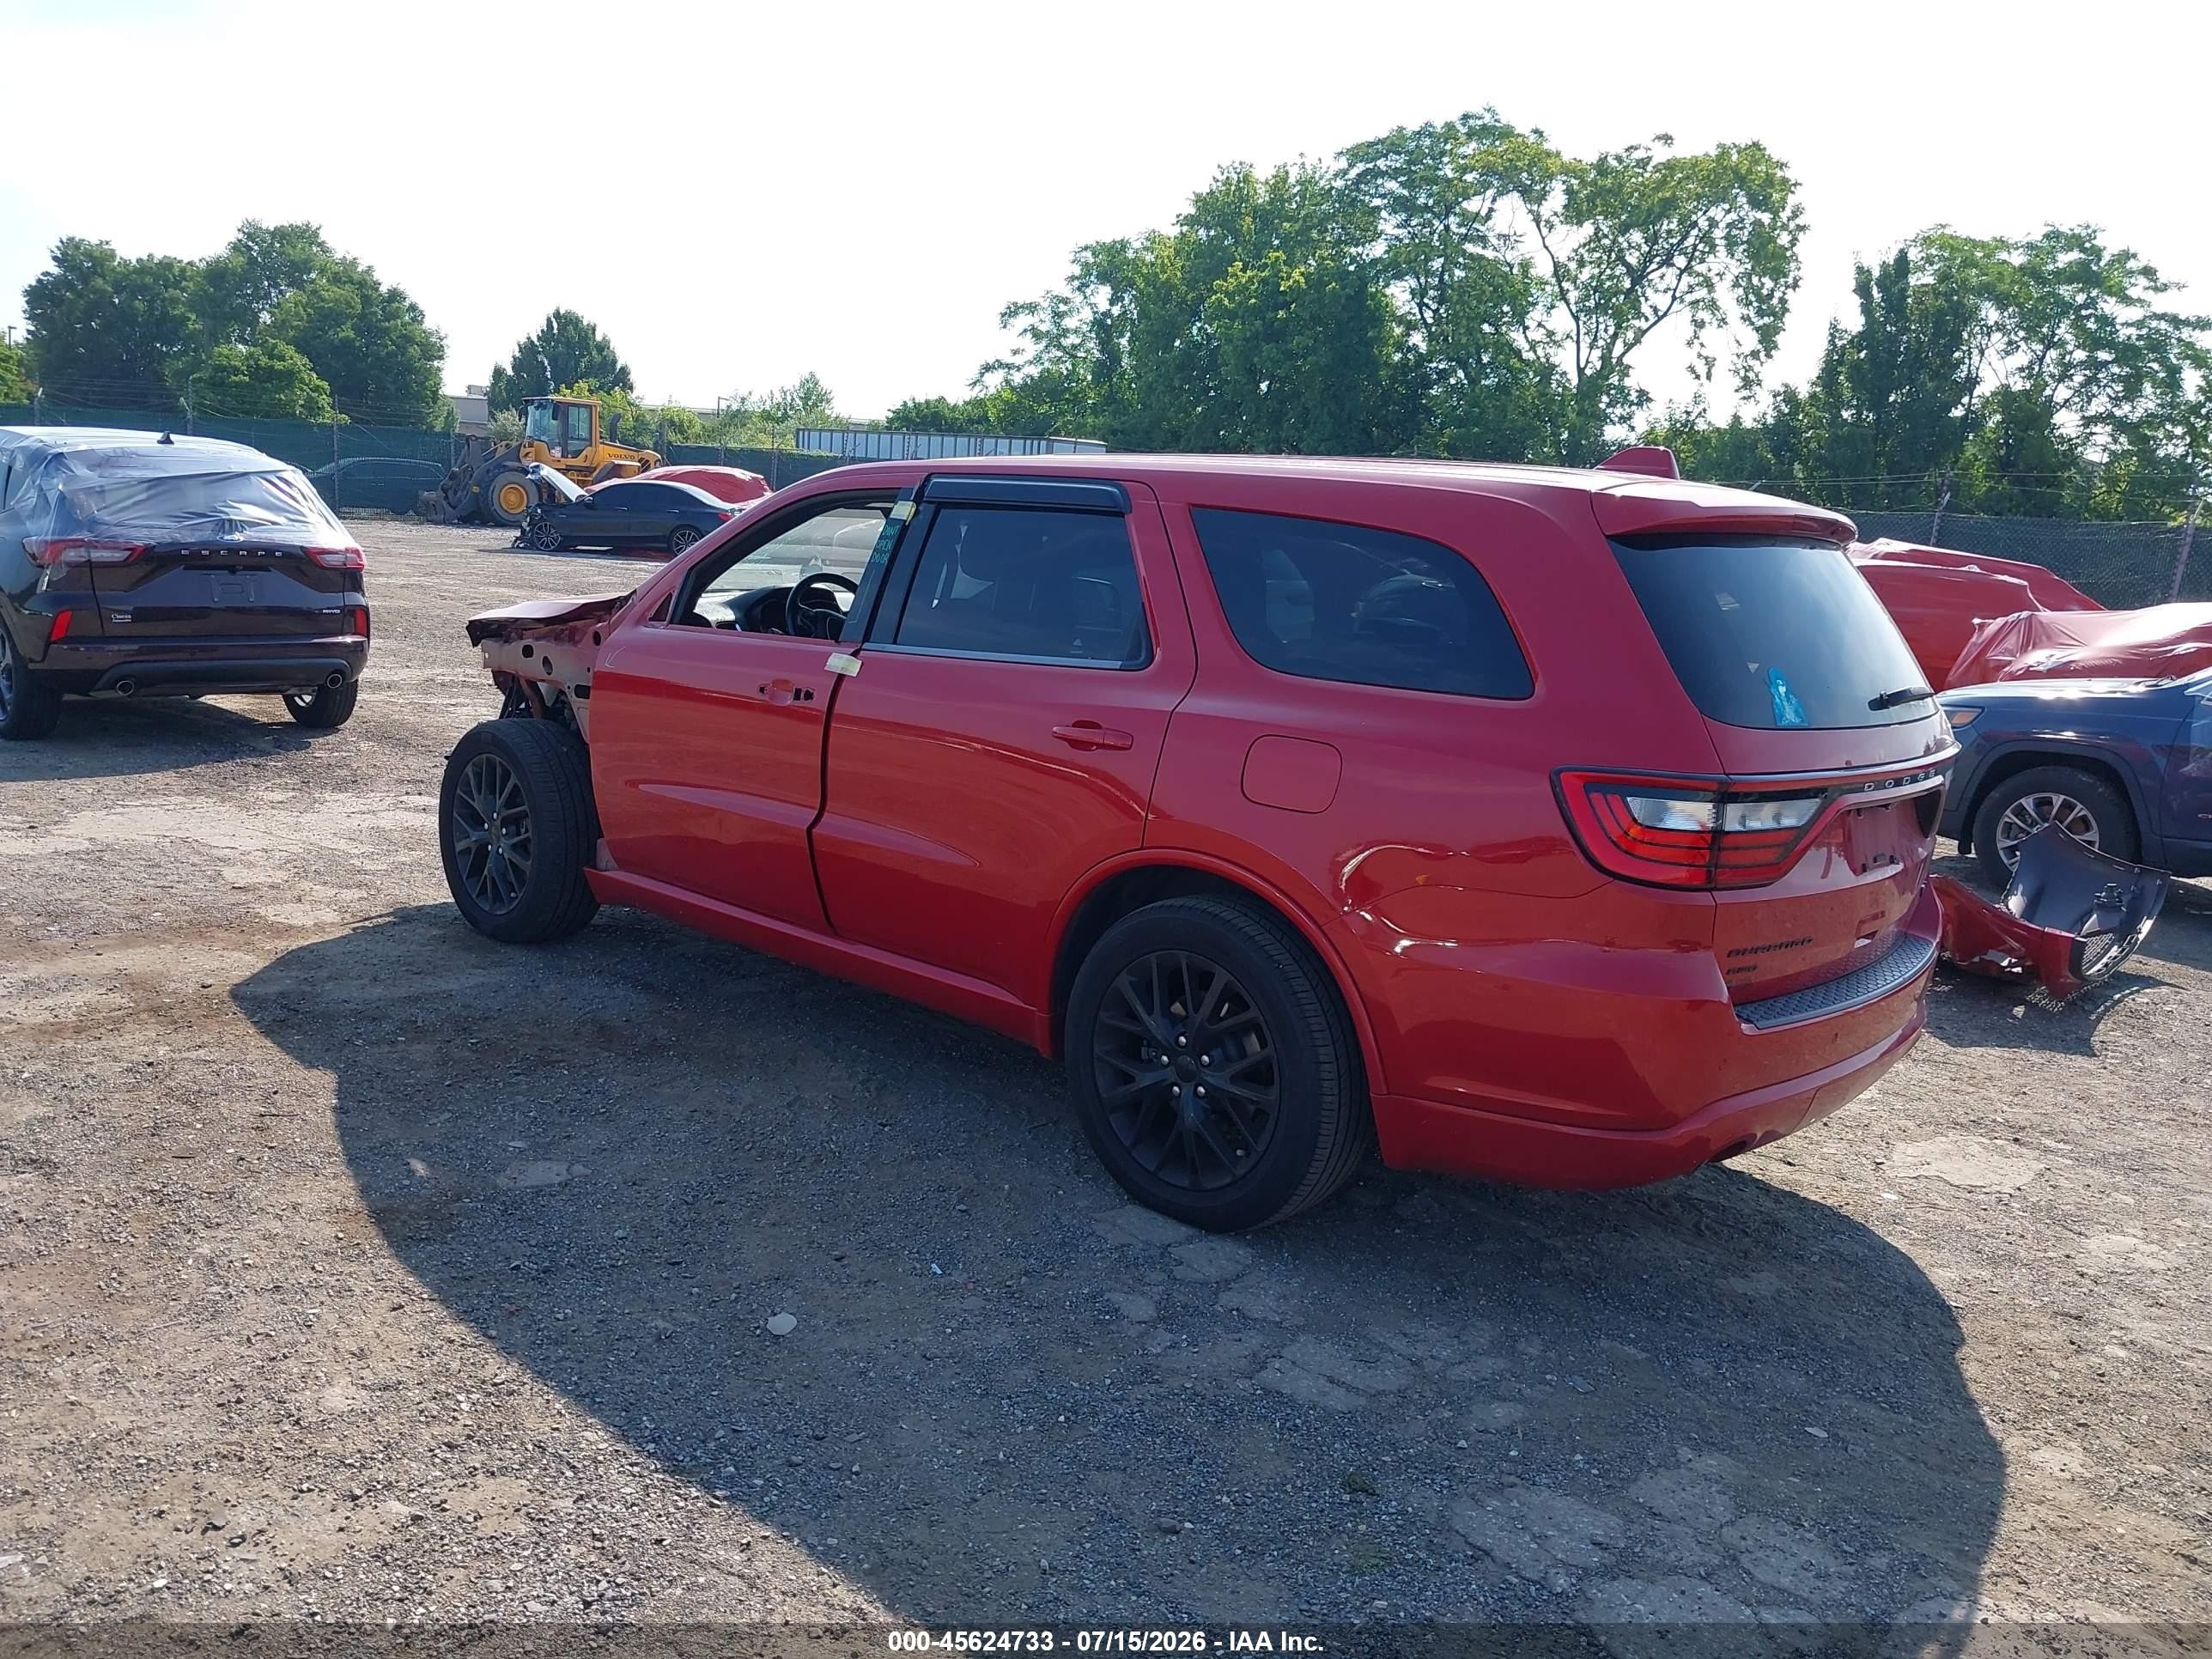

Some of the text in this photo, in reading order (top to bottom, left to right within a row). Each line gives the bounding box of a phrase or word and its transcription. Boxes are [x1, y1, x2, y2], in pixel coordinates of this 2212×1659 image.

[876, 539, 893, 550] OPEN
[872, 552, 890, 564] DOOR
[1864, 769, 1936, 791] DODGE
